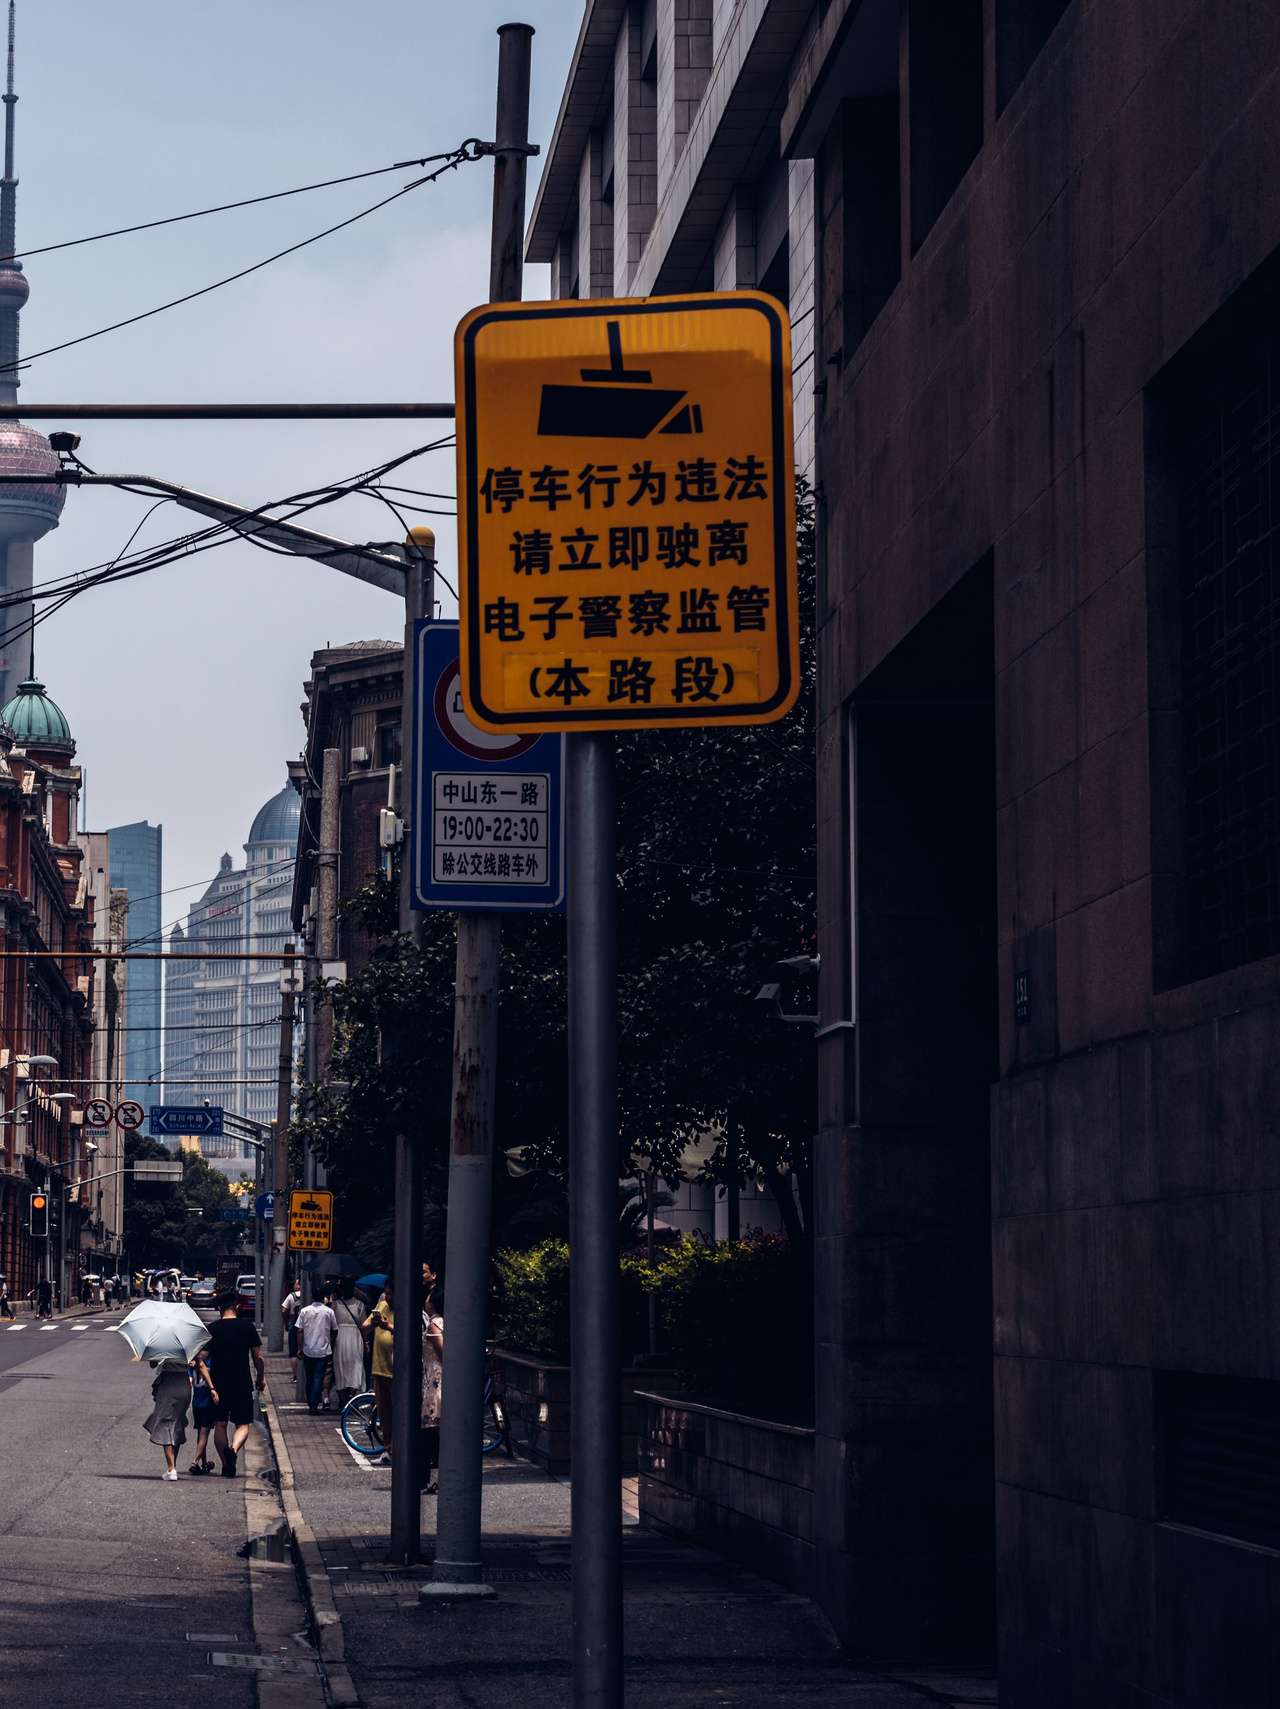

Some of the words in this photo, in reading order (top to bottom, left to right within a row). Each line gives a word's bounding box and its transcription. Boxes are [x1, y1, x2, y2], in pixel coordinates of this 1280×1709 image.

[479, 455, 768, 514] 停车行为违法
[510, 520, 748, 576] 请立即驶离
[484, 586, 770, 642] 电子警察监管
[442, 780, 539, 806] 中山东一路
[442, 815, 539, 842] 19:00-22:30
[442, 852, 539, 877] 除公交线路车外
[169, 1113, 203, 1122] 四川中路
